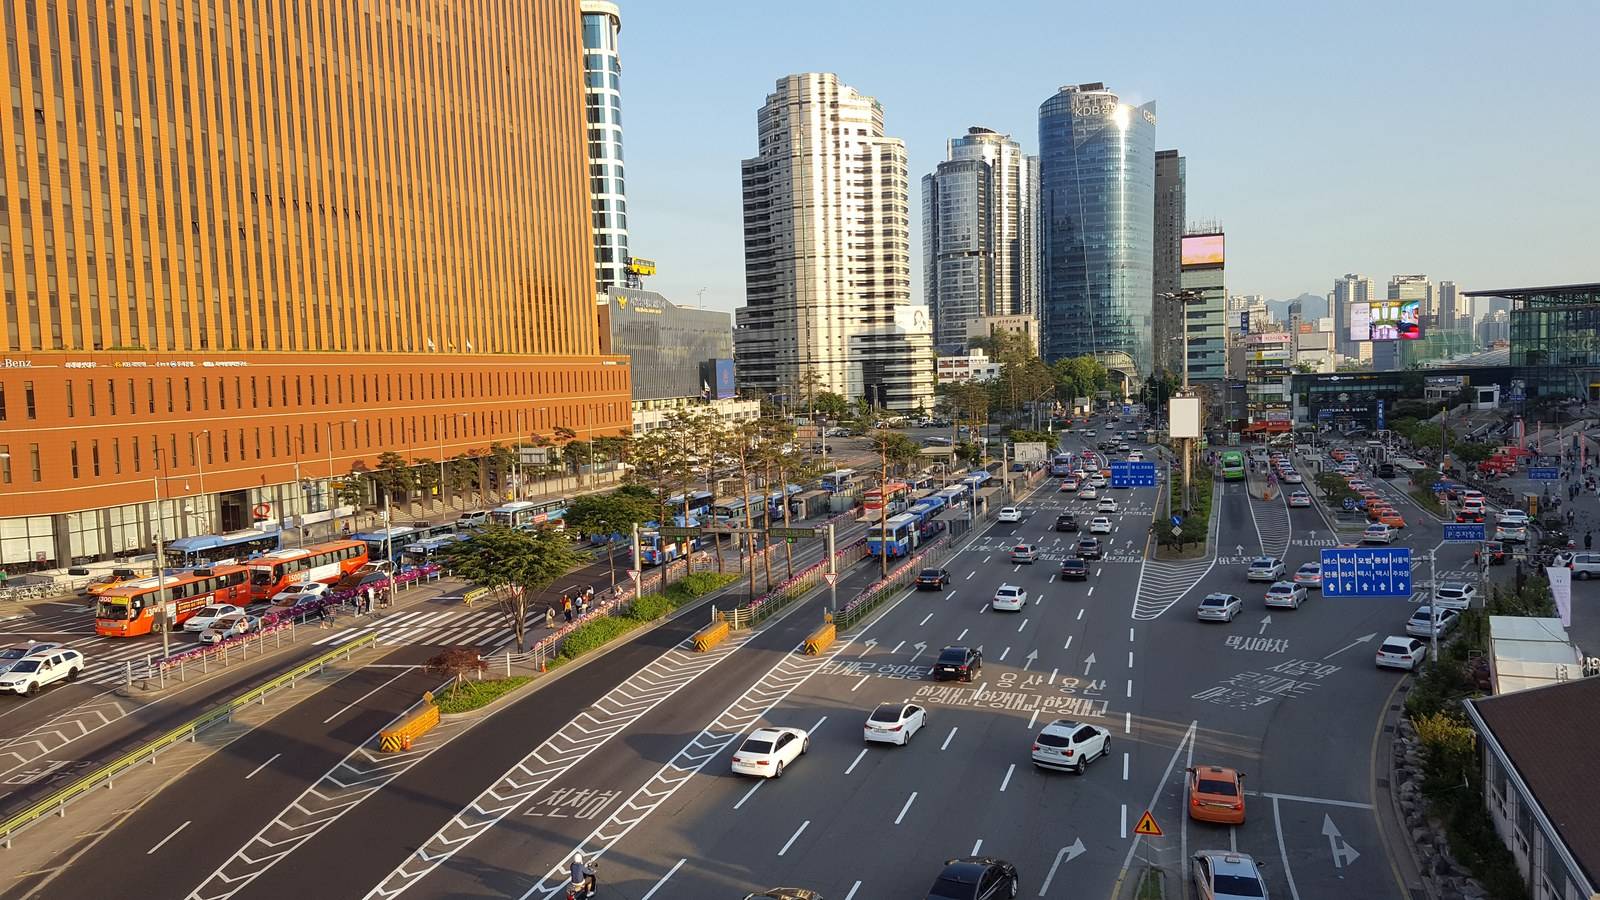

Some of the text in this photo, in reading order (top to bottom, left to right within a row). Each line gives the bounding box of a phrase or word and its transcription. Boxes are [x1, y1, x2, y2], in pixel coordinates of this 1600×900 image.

[1393, 570, 1409, 578] 주차장
[1224, 635, 1289, 653] 택시하차
[817, 660, 927, 680] 퇴계로 후암동
[1266, 658, 1344, 680] 서울역
[997, 672, 1044, 691] 용산
[1060, 677, 1107, 696] 용산
[911, 685, 977, 706] 한강대교
[975, 691, 1042, 712] 한강대교
[1041, 695, 1109, 718] 한강대교
[522, 787, 623, 820] 천천히
